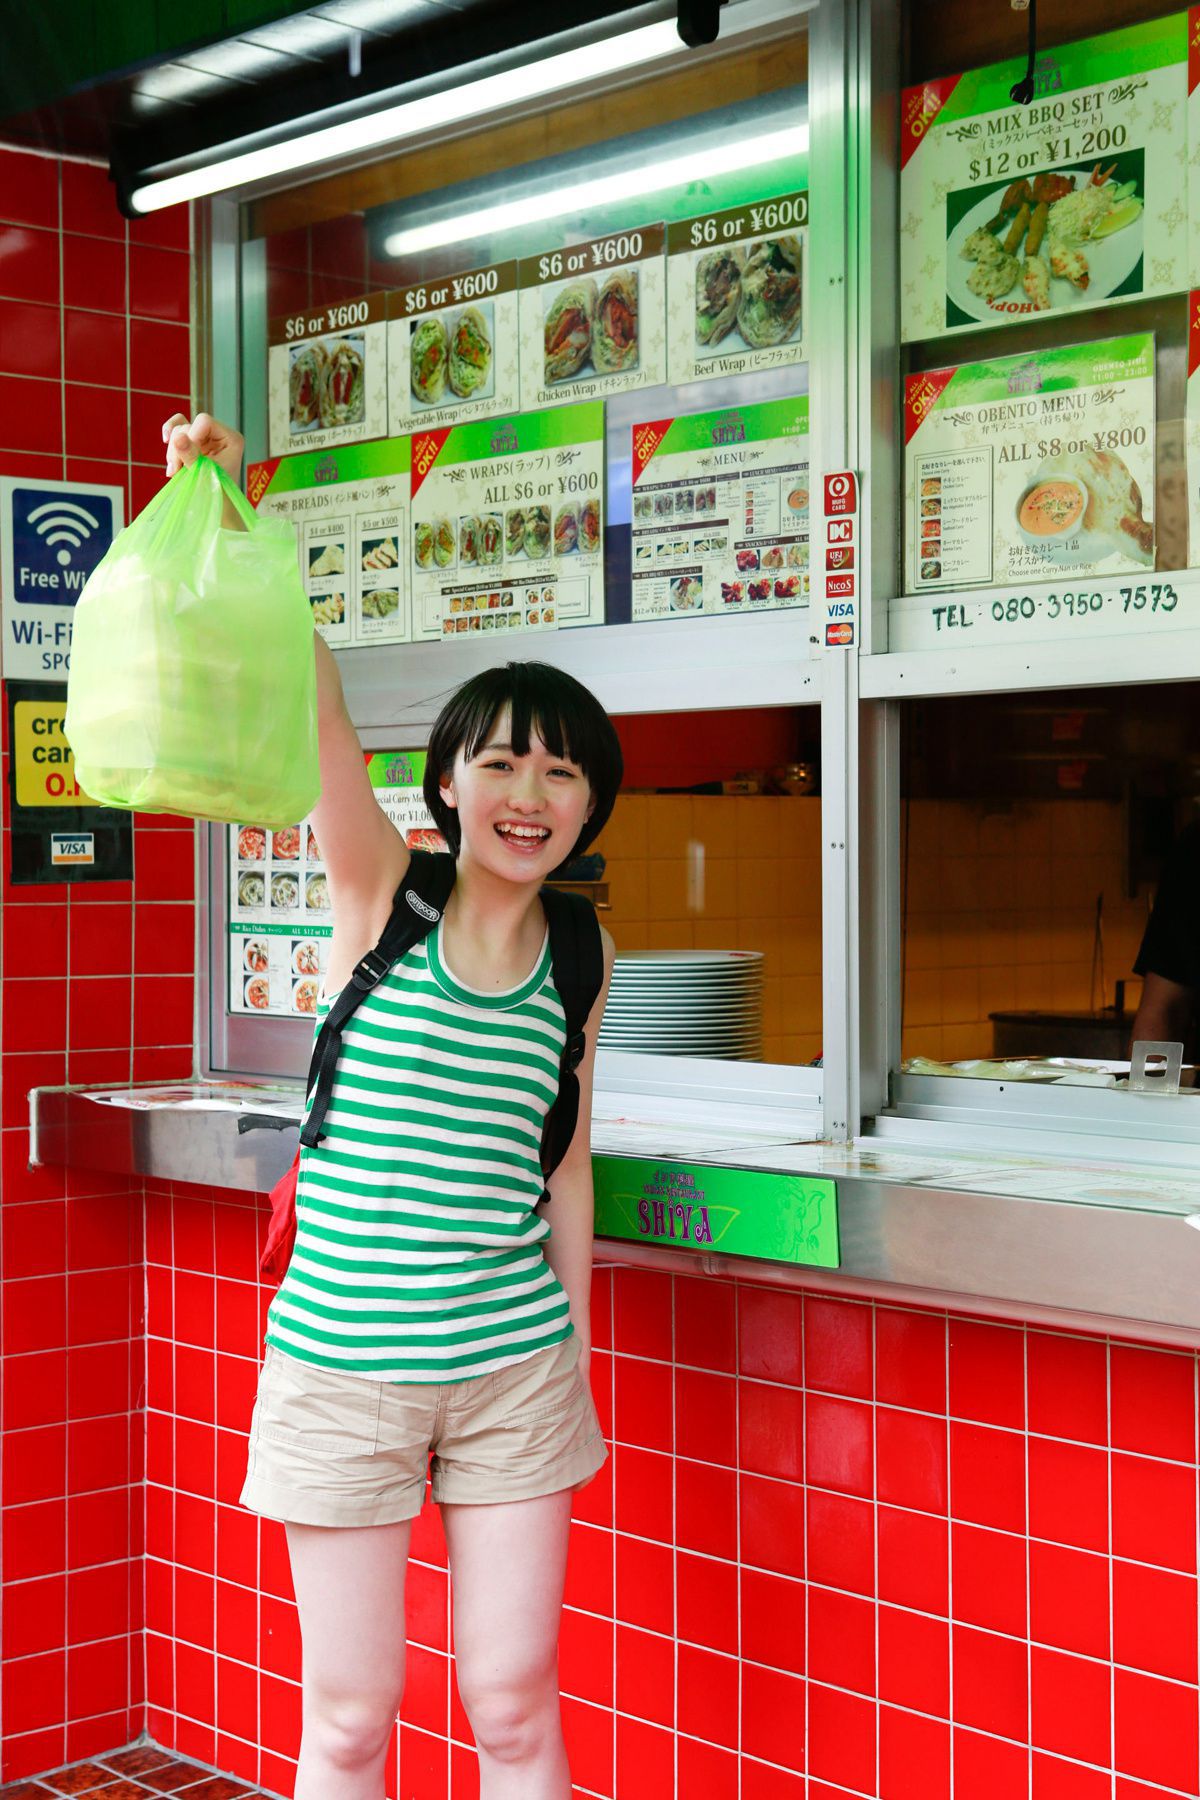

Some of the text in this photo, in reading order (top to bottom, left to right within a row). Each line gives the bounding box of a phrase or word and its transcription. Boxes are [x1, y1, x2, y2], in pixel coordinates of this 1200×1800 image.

[911, 93, 941, 137] OK!!
[987, 92, 1104, 136] MIX BBQ SET
[969, 124, 1126, 181] $12 or ¥1,200
[690, 197, 808, 247] $6 or ¥600
[539, 233, 642, 280] $6 or ¥600
[405, 270, 498, 313] $6 or ¥600
[285, 301, 369, 339] $6 or ¥600
[694, 361, 717, 376] Beef
[719, 358, 745, 371] Wrap
[537, 388, 571, 402] Chicken
[572, 383, 596, 396] Wrap
[912, 382, 936, 415] OK!!
[399, 411, 434, 430] Vegetable
[436, 409, 458, 424] Wrap
[978, 393, 1087, 424] OBENTO MENU
[289, 437, 305, 449] Pork
[306, 434, 325, 446] Wrap
[638, 430, 657, 460] OK!!
[998, 426, 1146, 464] ALL $8 or ¥800
[417, 440, 438, 475] OK!!
[713, 451, 746, 466] MENU
[251, 471, 270, 502] OK!!
[484, 472, 598, 504] ALL $6 or ¥600
[362, 520, 371, 528] $5
[381, 516, 398, 526] ¥500
[829, 522, 850, 541] DC
[1008, 555, 1054, 566] ライスかナン
[1008, 568, 1029, 577] Choose
[20, 567, 60, 589] Free
[828, 603, 854, 617] VISA
[393, 793, 410, 806] Curry
[397, 813, 406, 821] or
[60, 843, 86, 854] VISA
[408, 893, 436, 919] OUTDOOR
